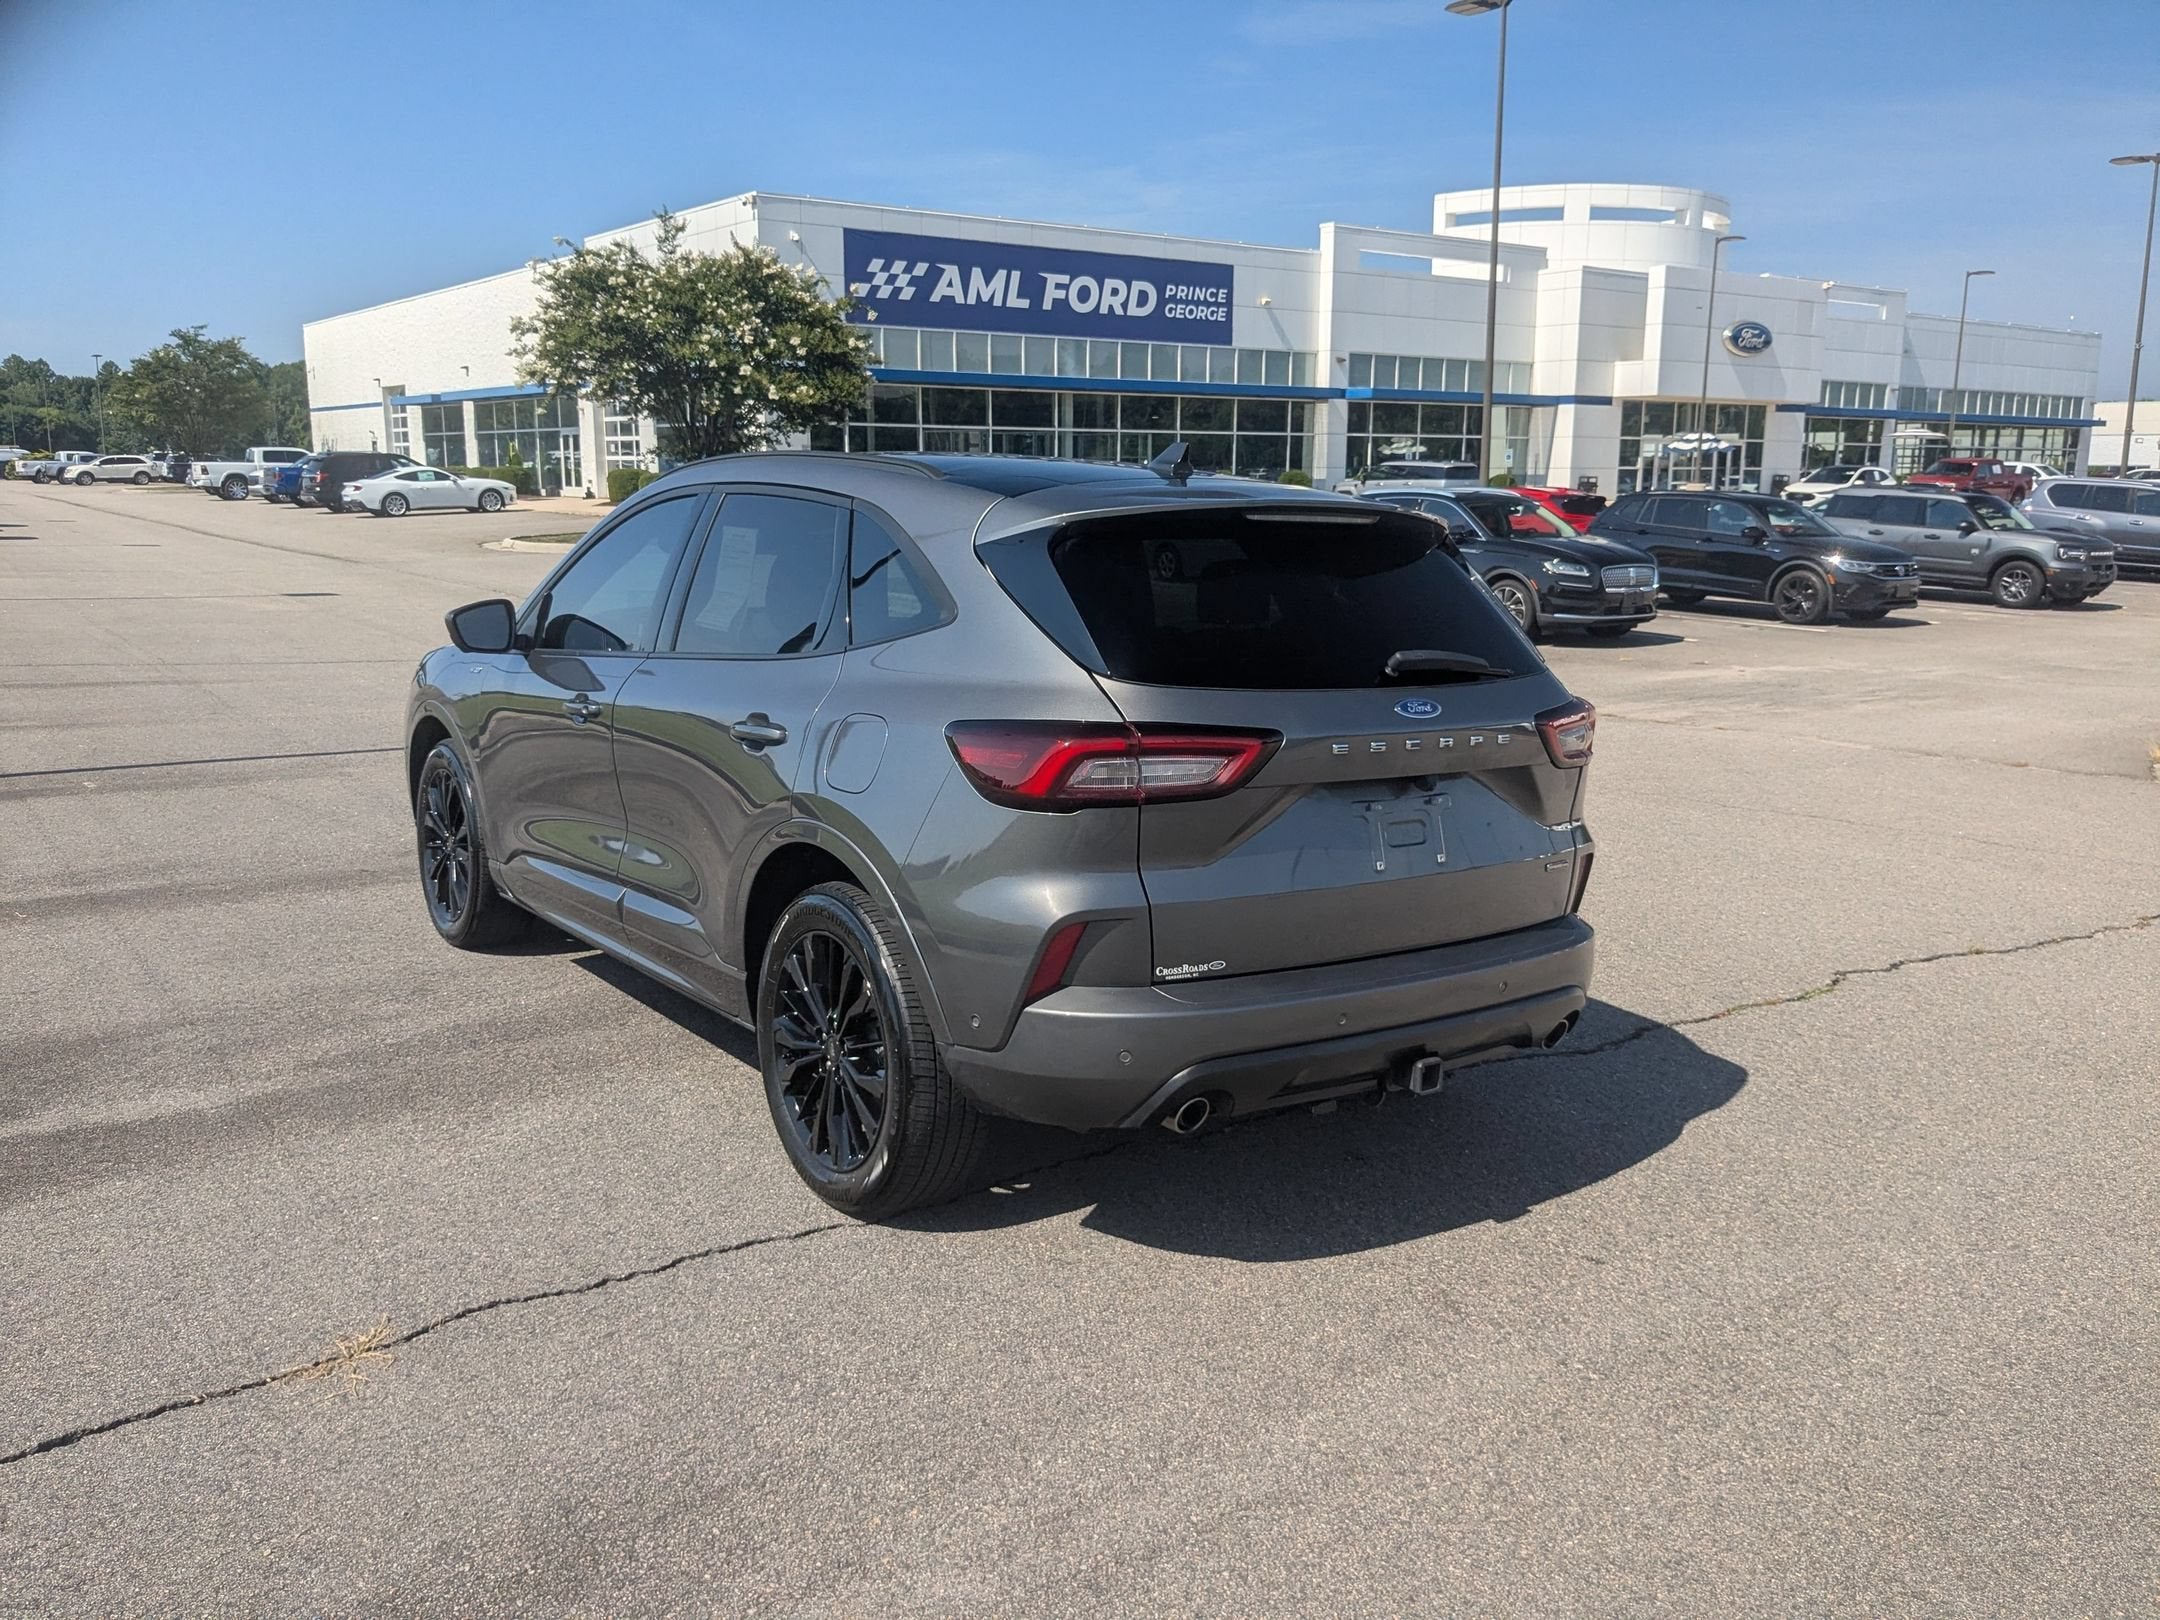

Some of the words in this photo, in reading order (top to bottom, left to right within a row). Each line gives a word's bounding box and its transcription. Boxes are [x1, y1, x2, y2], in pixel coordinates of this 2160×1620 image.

[929, 263, 1030, 309] AML
[1038, 272, 1157, 317] FORD
[1164, 284, 1228, 303] PRINCE
[1164, 303, 1227, 321] GEORGE
[1738, 328, 1766, 348] Ford
[1407, 700, 1433, 713] Ford
[1332, 734, 1511, 755] ESCAPE
